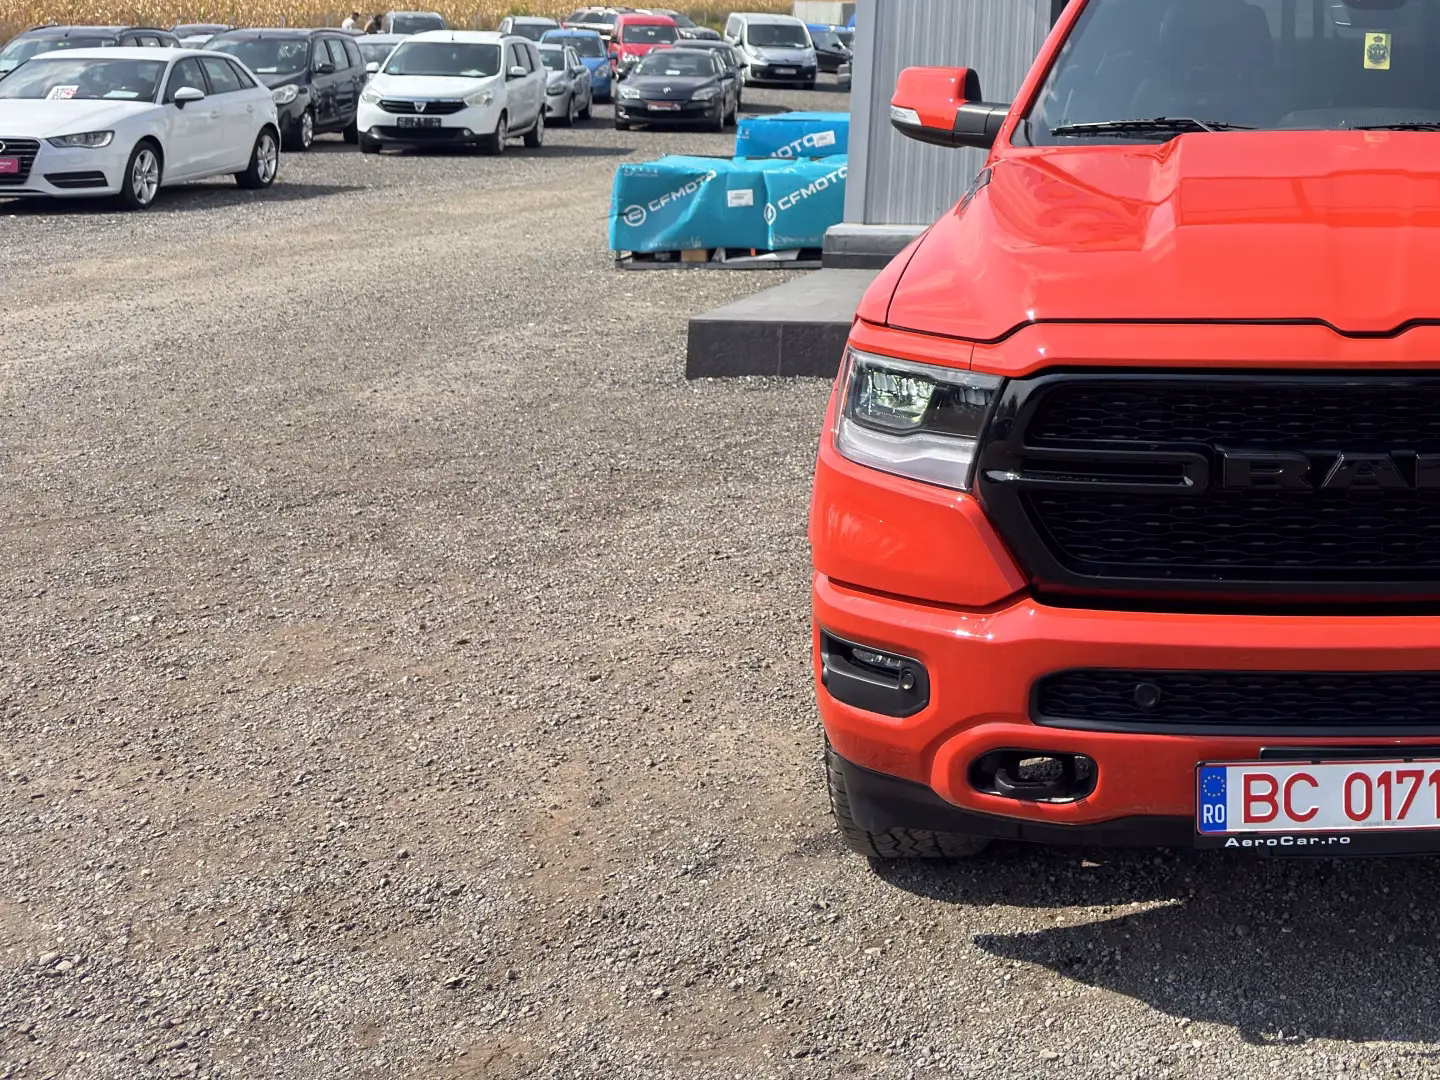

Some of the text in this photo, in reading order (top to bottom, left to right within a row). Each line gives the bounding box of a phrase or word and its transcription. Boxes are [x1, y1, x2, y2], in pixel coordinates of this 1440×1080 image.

[648, 169, 717, 212] CFMOTO
[778, 166, 848, 210] CFMOTO
[1203, 803, 1225, 824] RO
[1242, 773, 1319, 823] BC
[1224, 835, 1351, 847] AeroCar.ro
